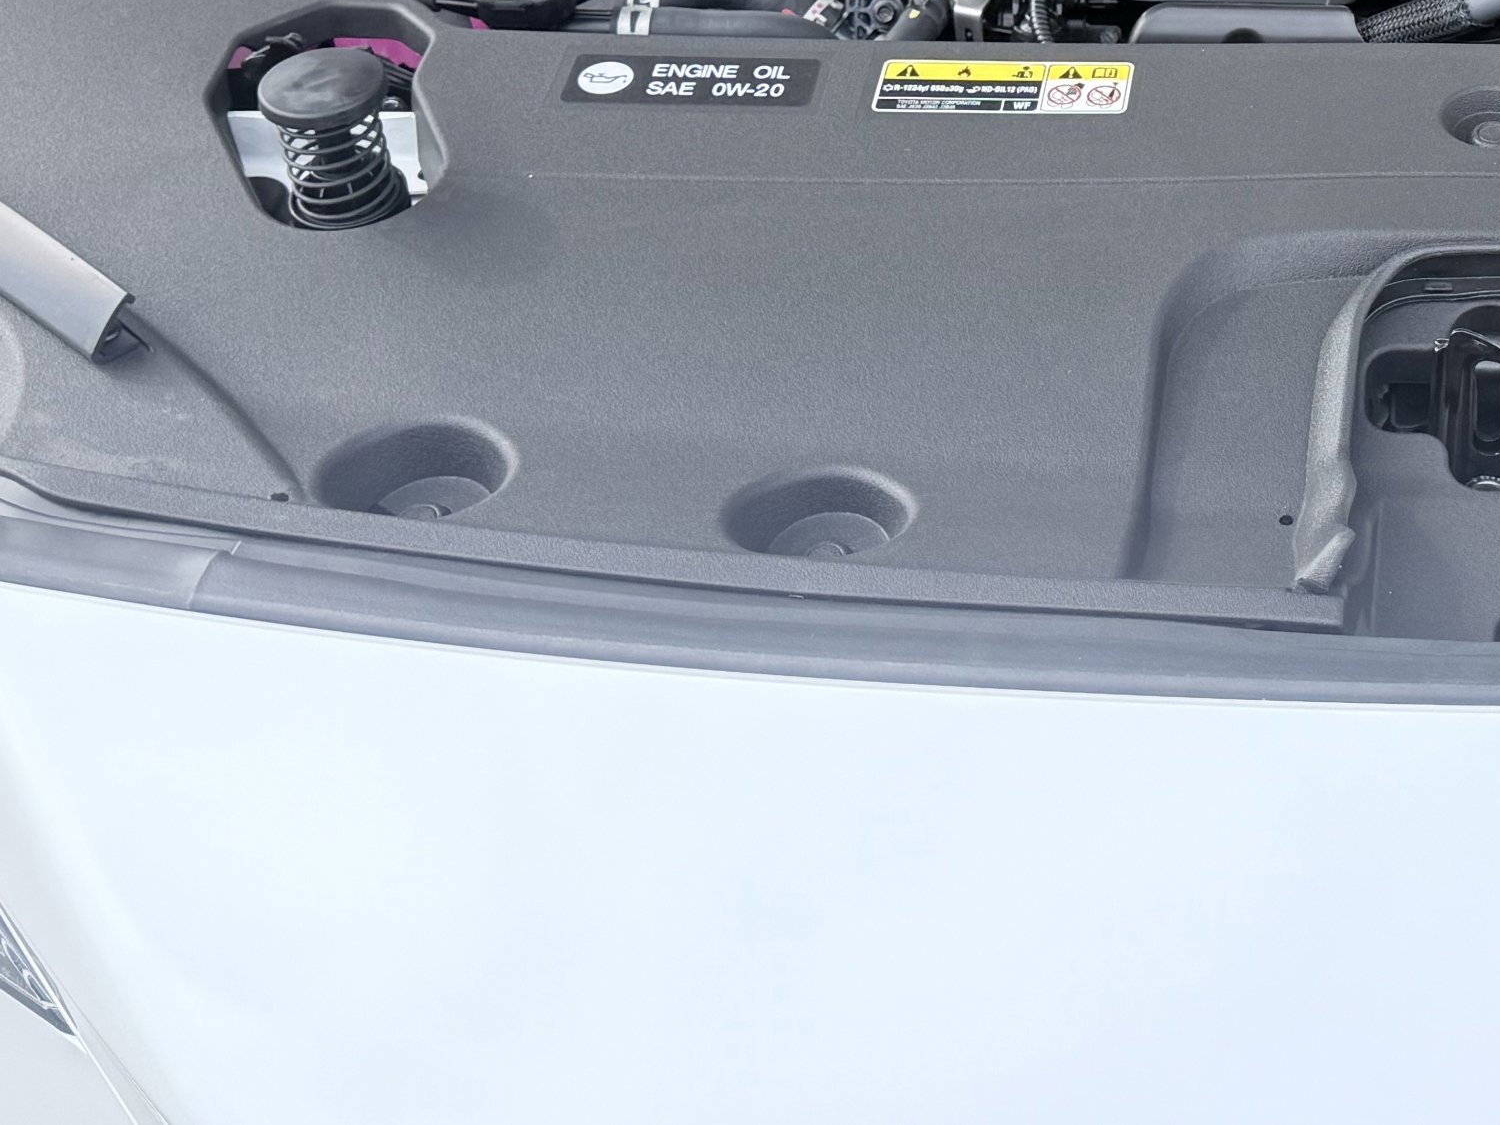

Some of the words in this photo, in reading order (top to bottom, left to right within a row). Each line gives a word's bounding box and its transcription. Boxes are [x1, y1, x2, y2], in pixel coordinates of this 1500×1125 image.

[651, 63, 740, 78] ENGINE
[753, 65, 791, 80] OIL
[646, 81, 697, 96] SAE
[711, 82, 785, 97] 0W-20
[1013, 101, 1032, 110] WF
